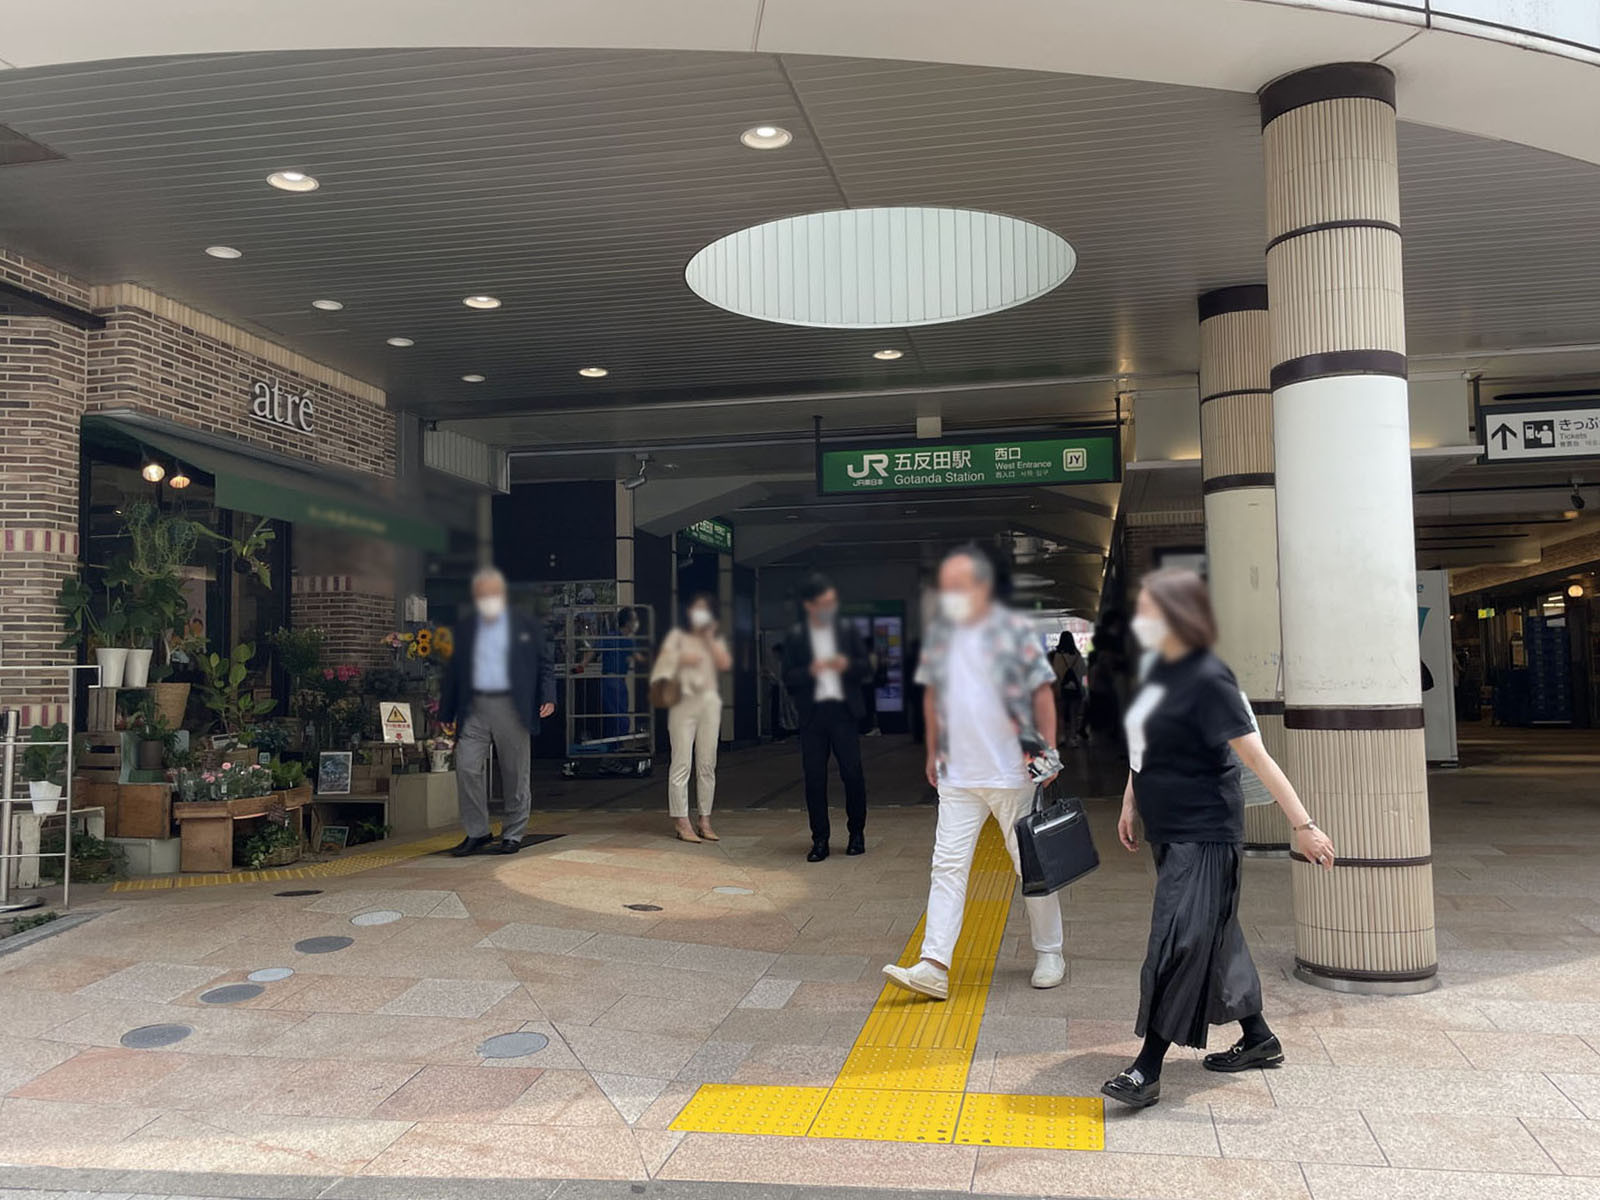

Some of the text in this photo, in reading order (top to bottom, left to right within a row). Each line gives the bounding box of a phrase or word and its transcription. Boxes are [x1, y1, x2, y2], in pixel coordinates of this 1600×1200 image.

[253, 378, 314, 431] atré
[894, 450, 971, 471] 五反田駅
[994, 447, 1021, 461] 西口
[1069, 455, 1081, 465] JY
[847, 454, 889, 478] JR
[995, 461, 1052, 470] West Entrance
[894, 471, 985, 485] Gotanda Station
